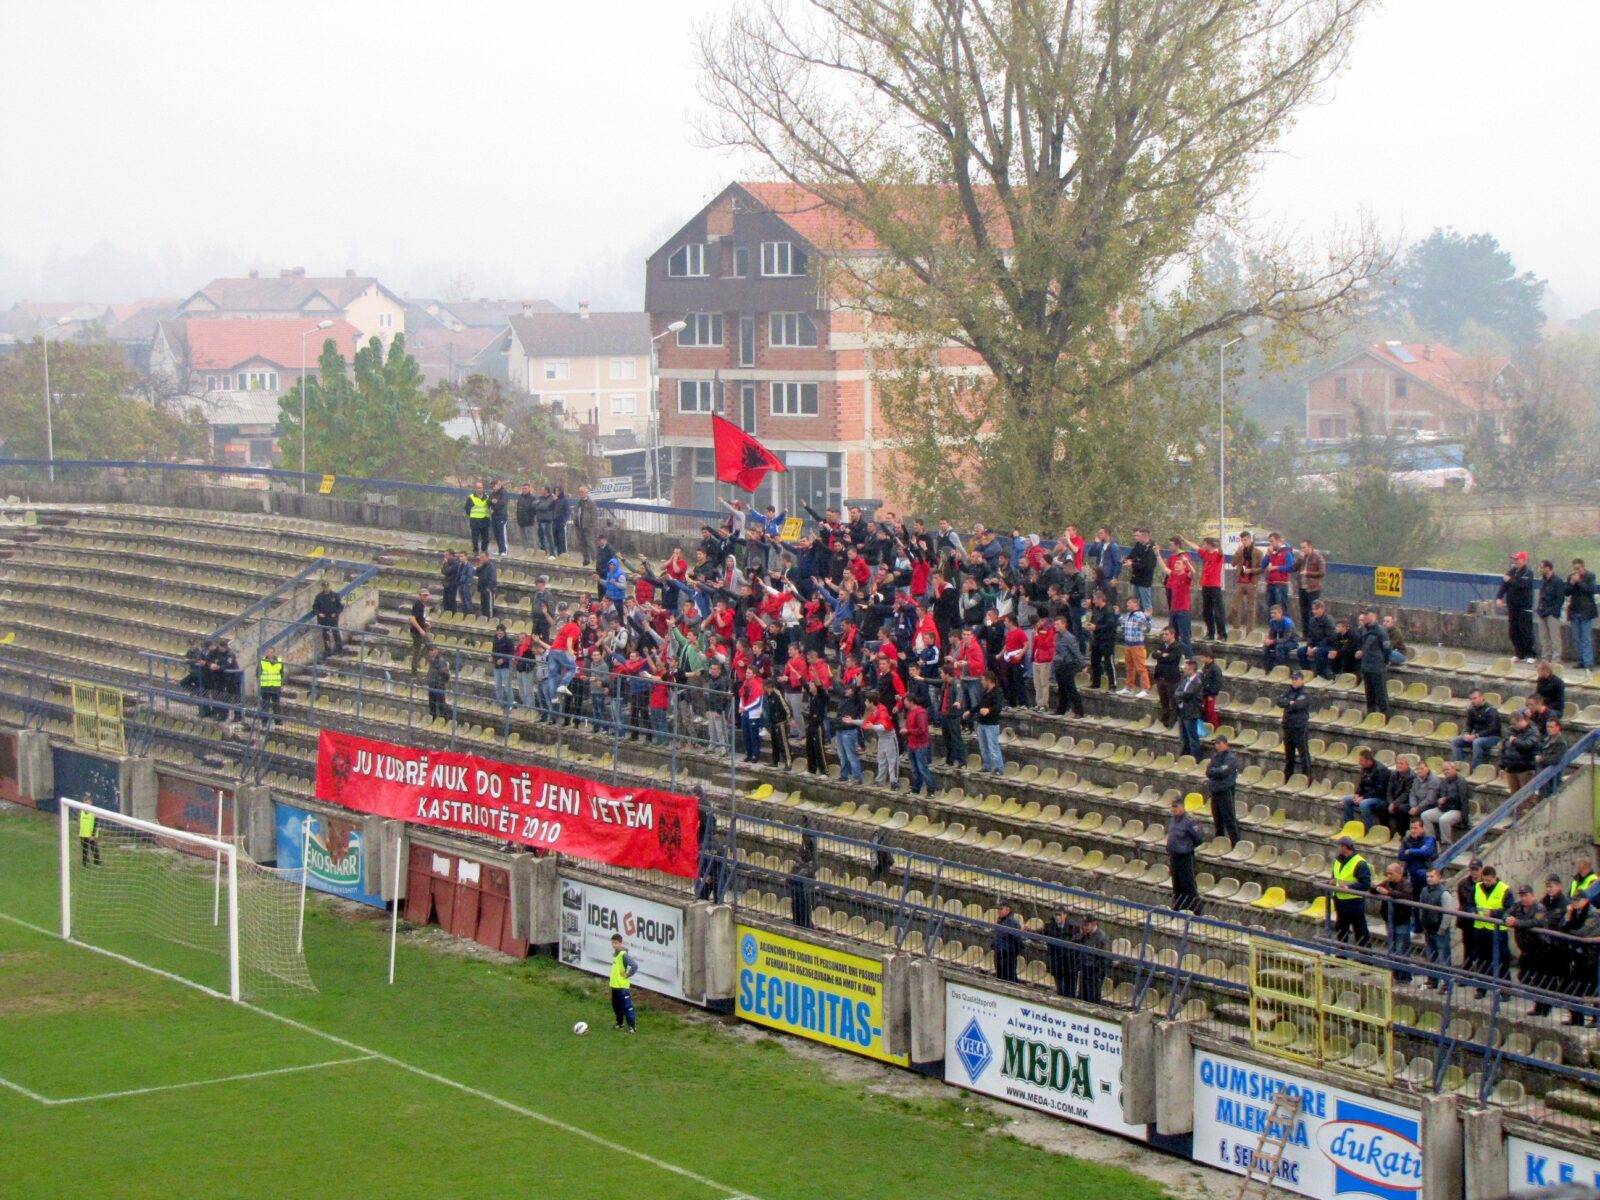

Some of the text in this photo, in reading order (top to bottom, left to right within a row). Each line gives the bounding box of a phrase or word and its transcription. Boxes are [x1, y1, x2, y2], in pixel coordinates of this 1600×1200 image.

[1389, 573, 1400, 592] 22
[353, 750, 653, 830] JU KURRË NUK DO TË JENI VETËM
[417, 797, 562, 843] KASTRIOTËT 2010
[587, 903, 675, 946] IDEA GROUP
[952, 990, 961, 1000] Das
[1007, 1017, 1043, 1035] Always
[1047, 1027, 1063, 1039] the
[1067, 1033, 1088, 1046] Best
[1020, 1007, 1066, 1028] Windows
[1071, 1022, 1090, 1034] and
[963, 1039, 984, 1056] VEKA
[1006, 1086, 1088, 1118] WWW.MEDA-3.COM.MK
